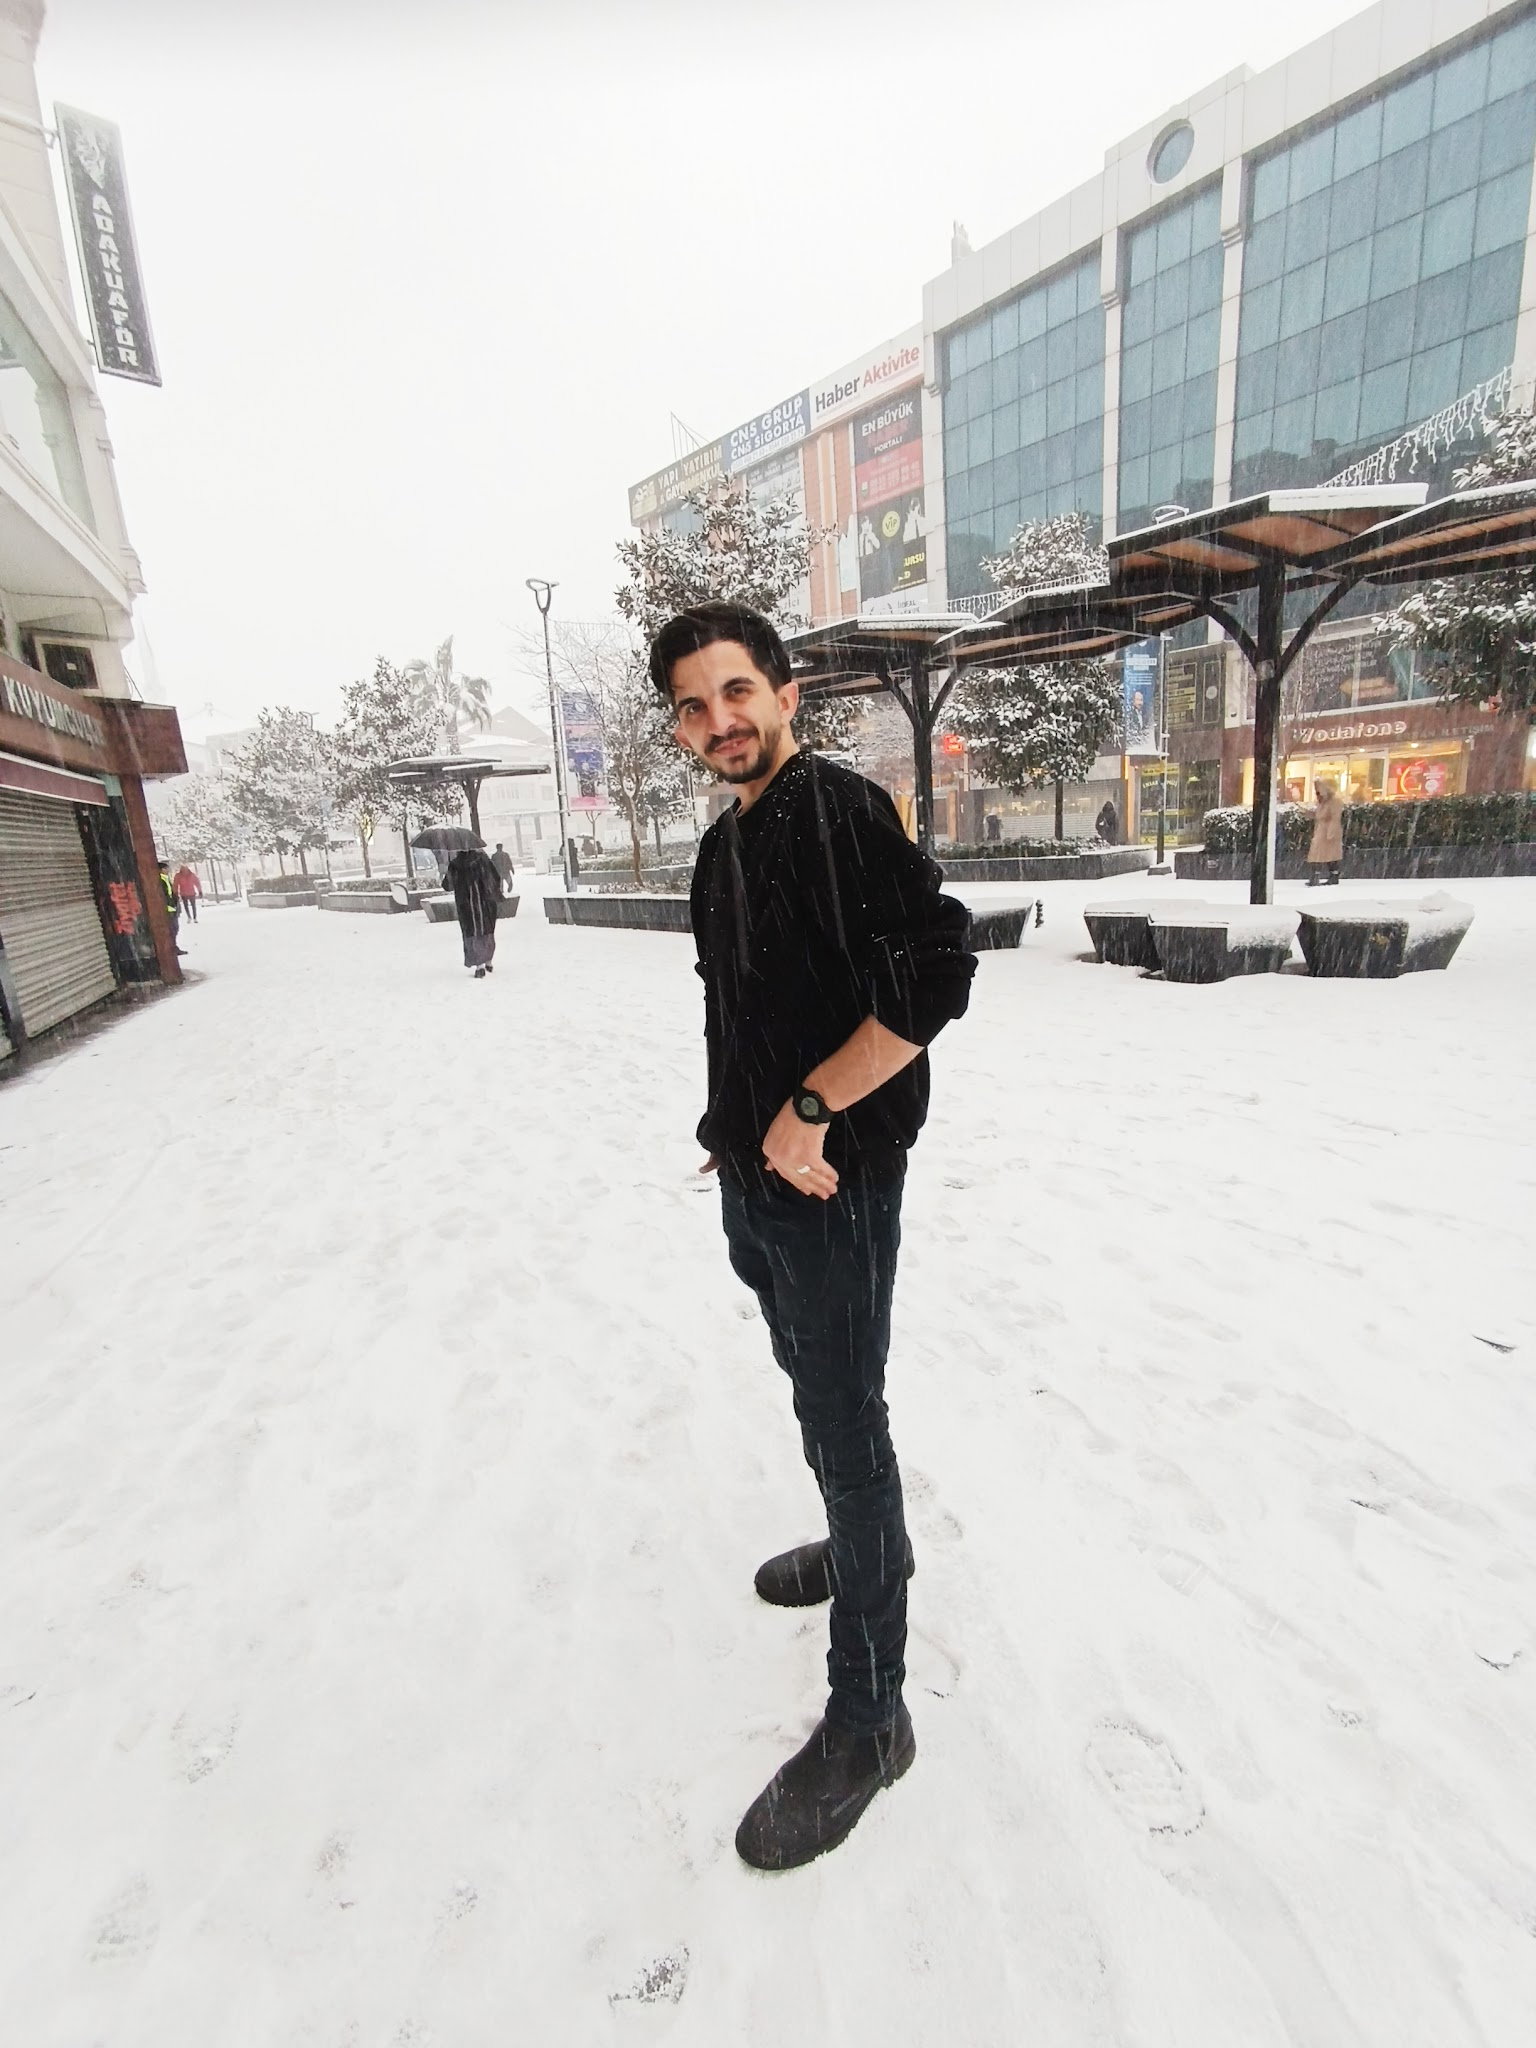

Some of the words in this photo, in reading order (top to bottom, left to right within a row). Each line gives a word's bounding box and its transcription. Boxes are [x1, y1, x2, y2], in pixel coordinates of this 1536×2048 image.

[815, 376, 861, 413] Haber
[862, 346, 920, 388] Aktivite
[730, 421, 757, 448] CNS
[761, 394, 803, 431] GRUP
[861, 419, 876, 437] EN
[876, 400, 914, 430] BÜYÜK
[657, 466, 679, 490] YAPI
[682, 443, 723, 477] YATIRIM
[730, 440, 752, 460] CNS
